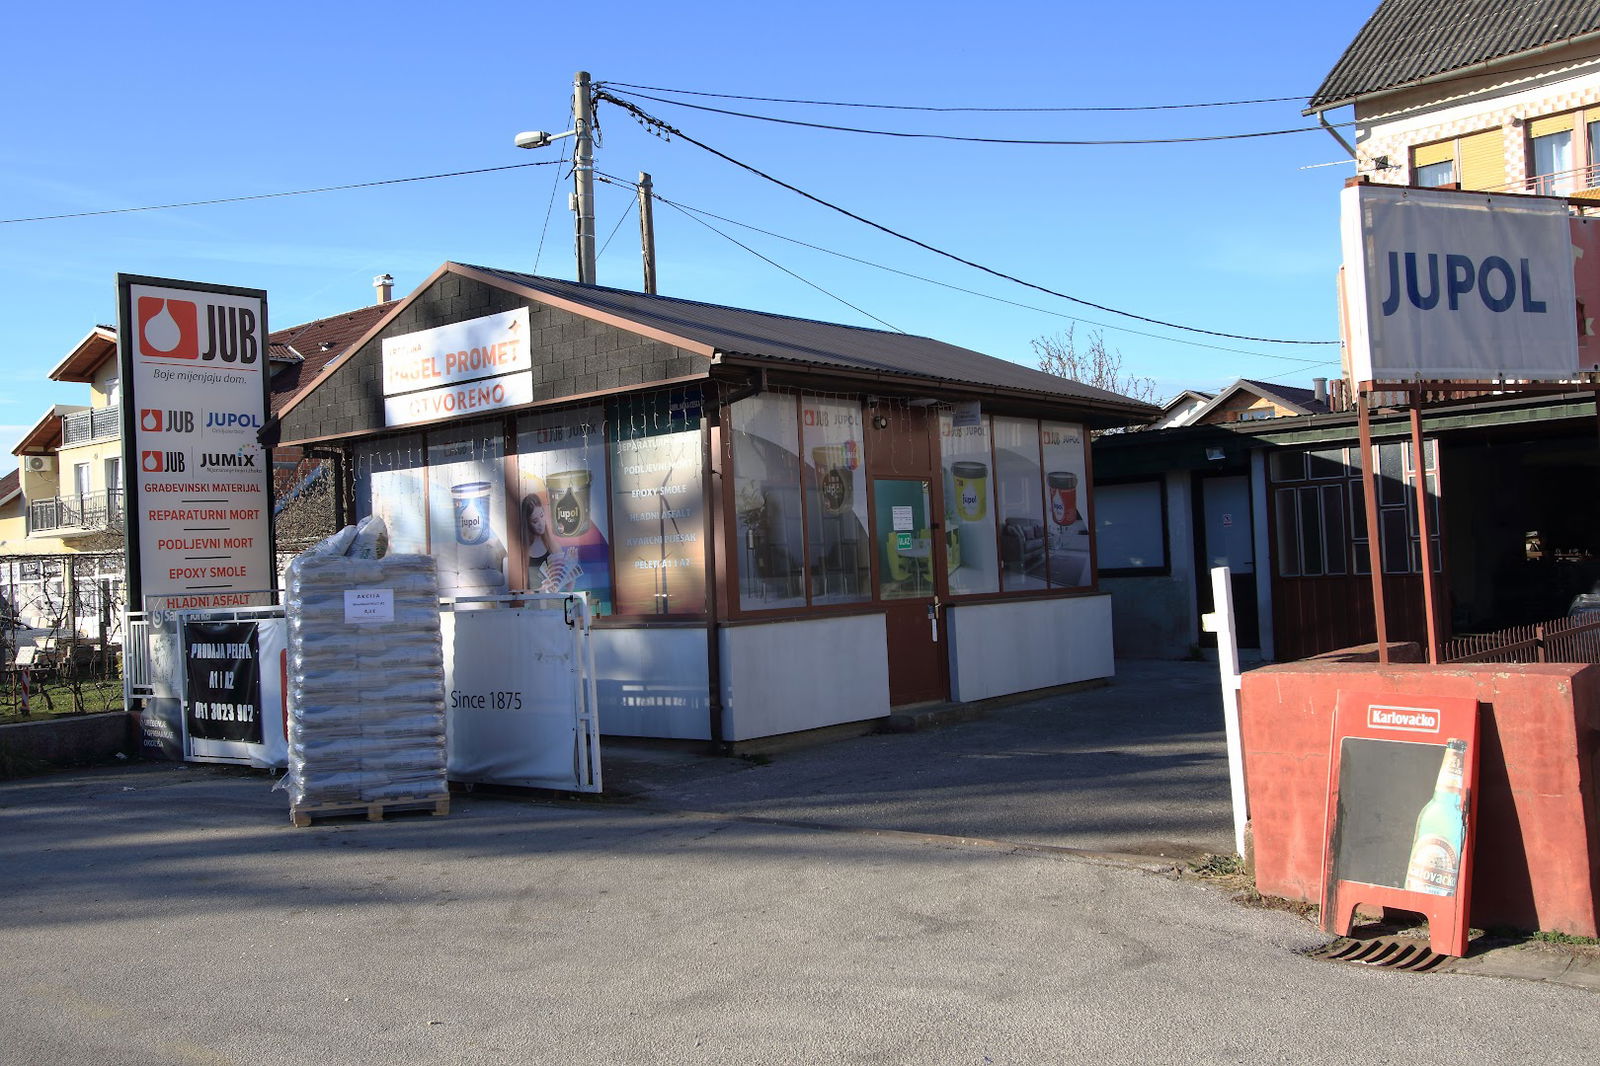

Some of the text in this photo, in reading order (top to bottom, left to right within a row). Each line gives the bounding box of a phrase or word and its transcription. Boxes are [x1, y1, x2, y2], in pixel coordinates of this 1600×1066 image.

[1382, 251, 1547, 316] JUPOL
[202, 304, 258, 364] JUB
[445, 339, 520, 376] PROMET
[153, 368, 247, 386] Boje mijenjaju dom.
[165, 410, 195, 433] JUB
[206, 412, 260, 428] JUPOL
[164, 451, 186, 473] JUB
[144, 483, 261, 493] GRAĐEVINSKI MATERIJAL
[631, 485, 687, 498] EPOXY SMOLE
[148, 509, 260, 521] REPARATURNI MORT
[461, 515, 480, 527] jupol
[557, 507, 578, 520] jupol
[158, 537, 254, 550] PODLJEVNI MORT
[169, 566, 246, 579] EPOXY SMOLE
[167, 594, 250, 609] HLADNI ASFALT
[190, 643, 226, 659] PRODAJA
[209, 670, 218, 689] A1
[224, 671, 234, 689] A2
[450, 690, 522, 710] Since 1875
